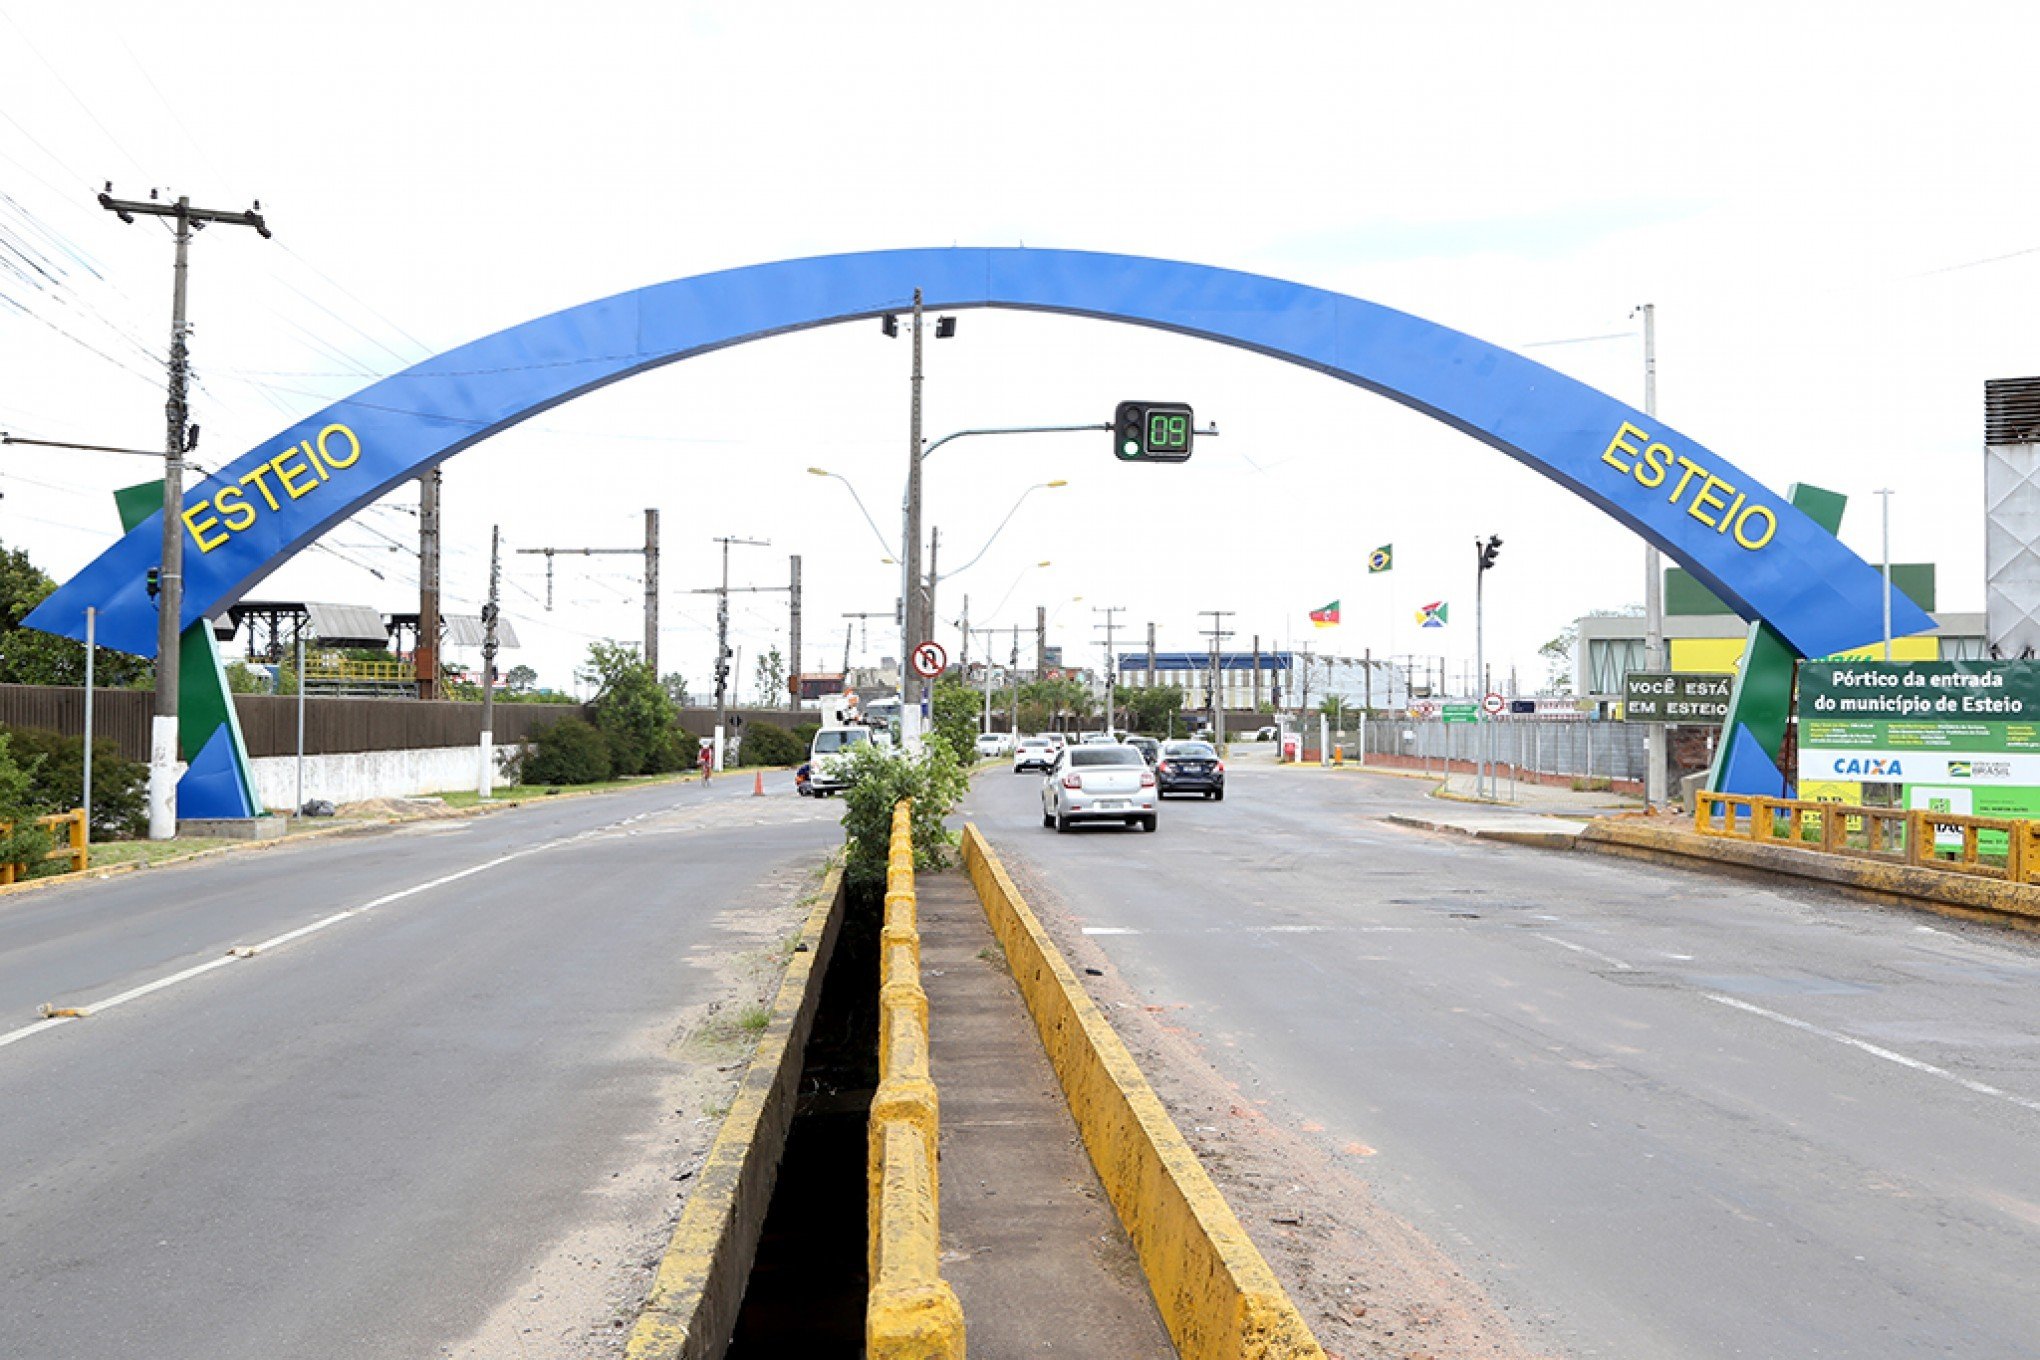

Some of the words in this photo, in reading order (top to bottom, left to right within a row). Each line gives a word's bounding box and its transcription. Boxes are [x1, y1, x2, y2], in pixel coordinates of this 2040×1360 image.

[1151, 415, 1186, 446] 09
[181, 423, 361, 553] ESTEIO
[1601, 420, 1778, 550] ESTEIO
[1629, 677, 1675, 694] VOCÊ
[1685, 680, 1729, 696] ESTÁ
[1832, 671, 1898, 687] Pórtico
[1902, 671, 1925, 686] da
[1930, 671, 2003, 687] entrada
[1628, 701, 1656, 714] EM
[1667, 702, 1728, 715] ESTEIO
[1814, 695, 1836, 710] do
[1840, 695, 1931, 715] município
[1935, 695, 1957, 711] de
[1962, 696, 2022, 712] Esteio
[1833, 758, 1903, 775] CAIXA
